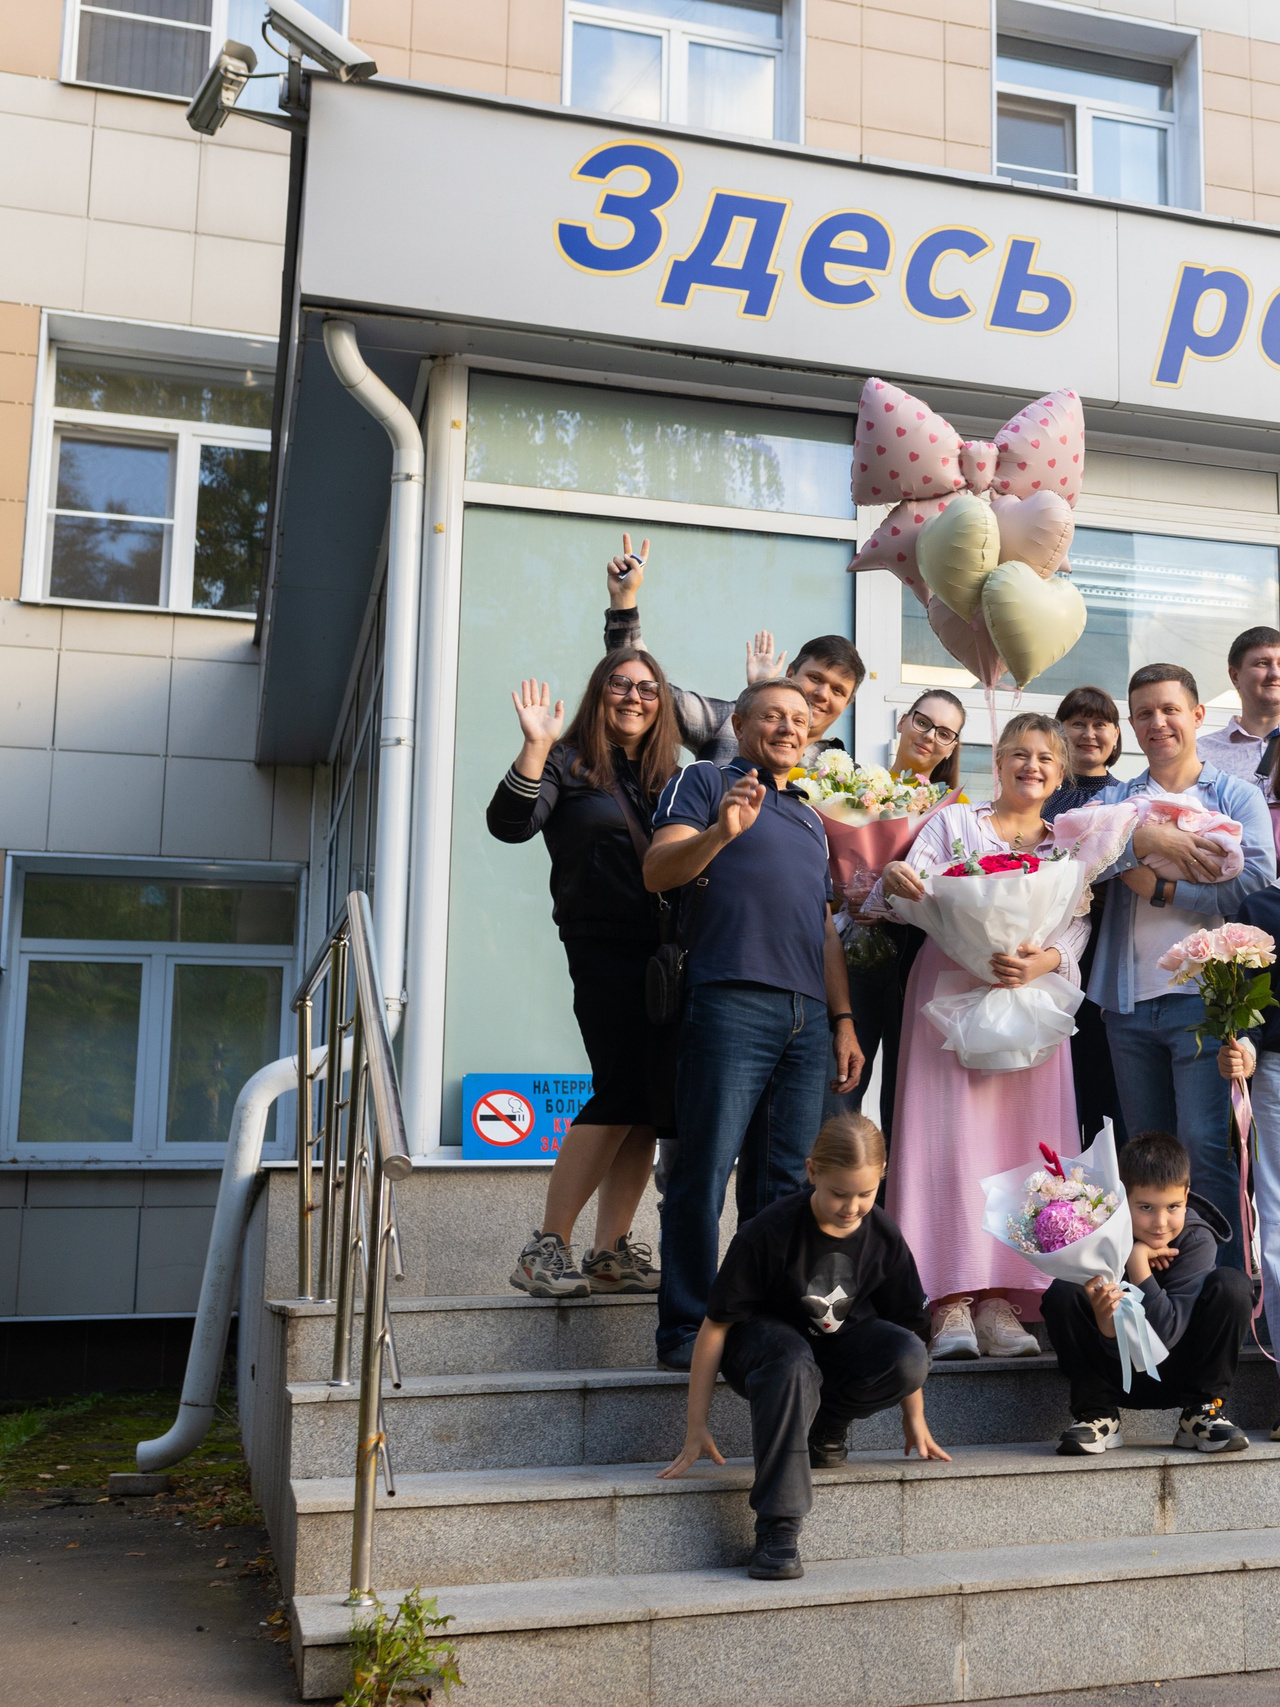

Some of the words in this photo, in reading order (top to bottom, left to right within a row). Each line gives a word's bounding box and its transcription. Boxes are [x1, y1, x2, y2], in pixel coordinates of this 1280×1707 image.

[555, 139, 1077, 337] Здесь
[533, 1080, 550, 1094] НА
[553, 1080, 595, 1095] ТЕРРИ
[546, 1099, 585, 1113] БОЛЬ
[554, 1117, 572, 1133] КУ
[541, 1136, 565, 1152] ЗА
